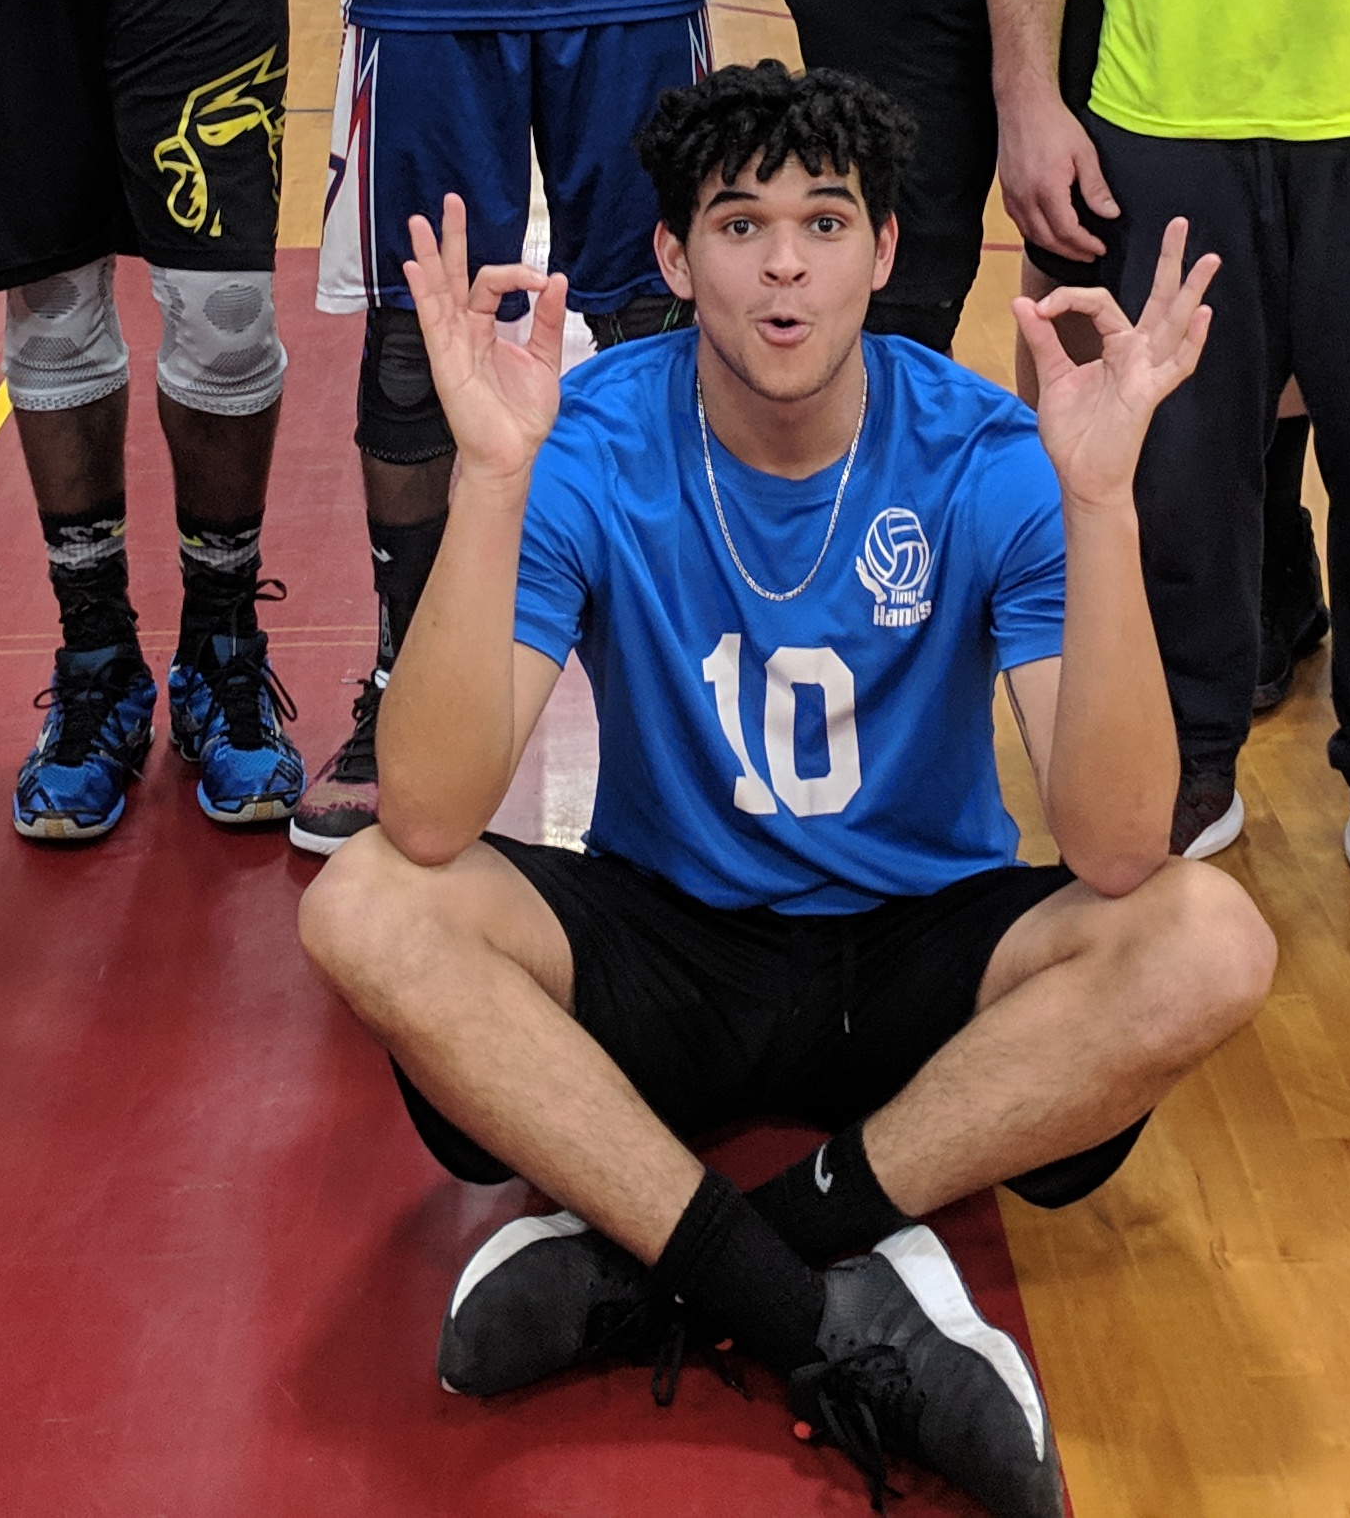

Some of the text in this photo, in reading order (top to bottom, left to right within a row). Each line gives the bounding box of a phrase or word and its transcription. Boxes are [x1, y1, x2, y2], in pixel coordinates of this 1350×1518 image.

[890, 589, 916, 605] Tiny
[873, 600, 931, 627] Hands
[702, 633, 862, 818] 10
